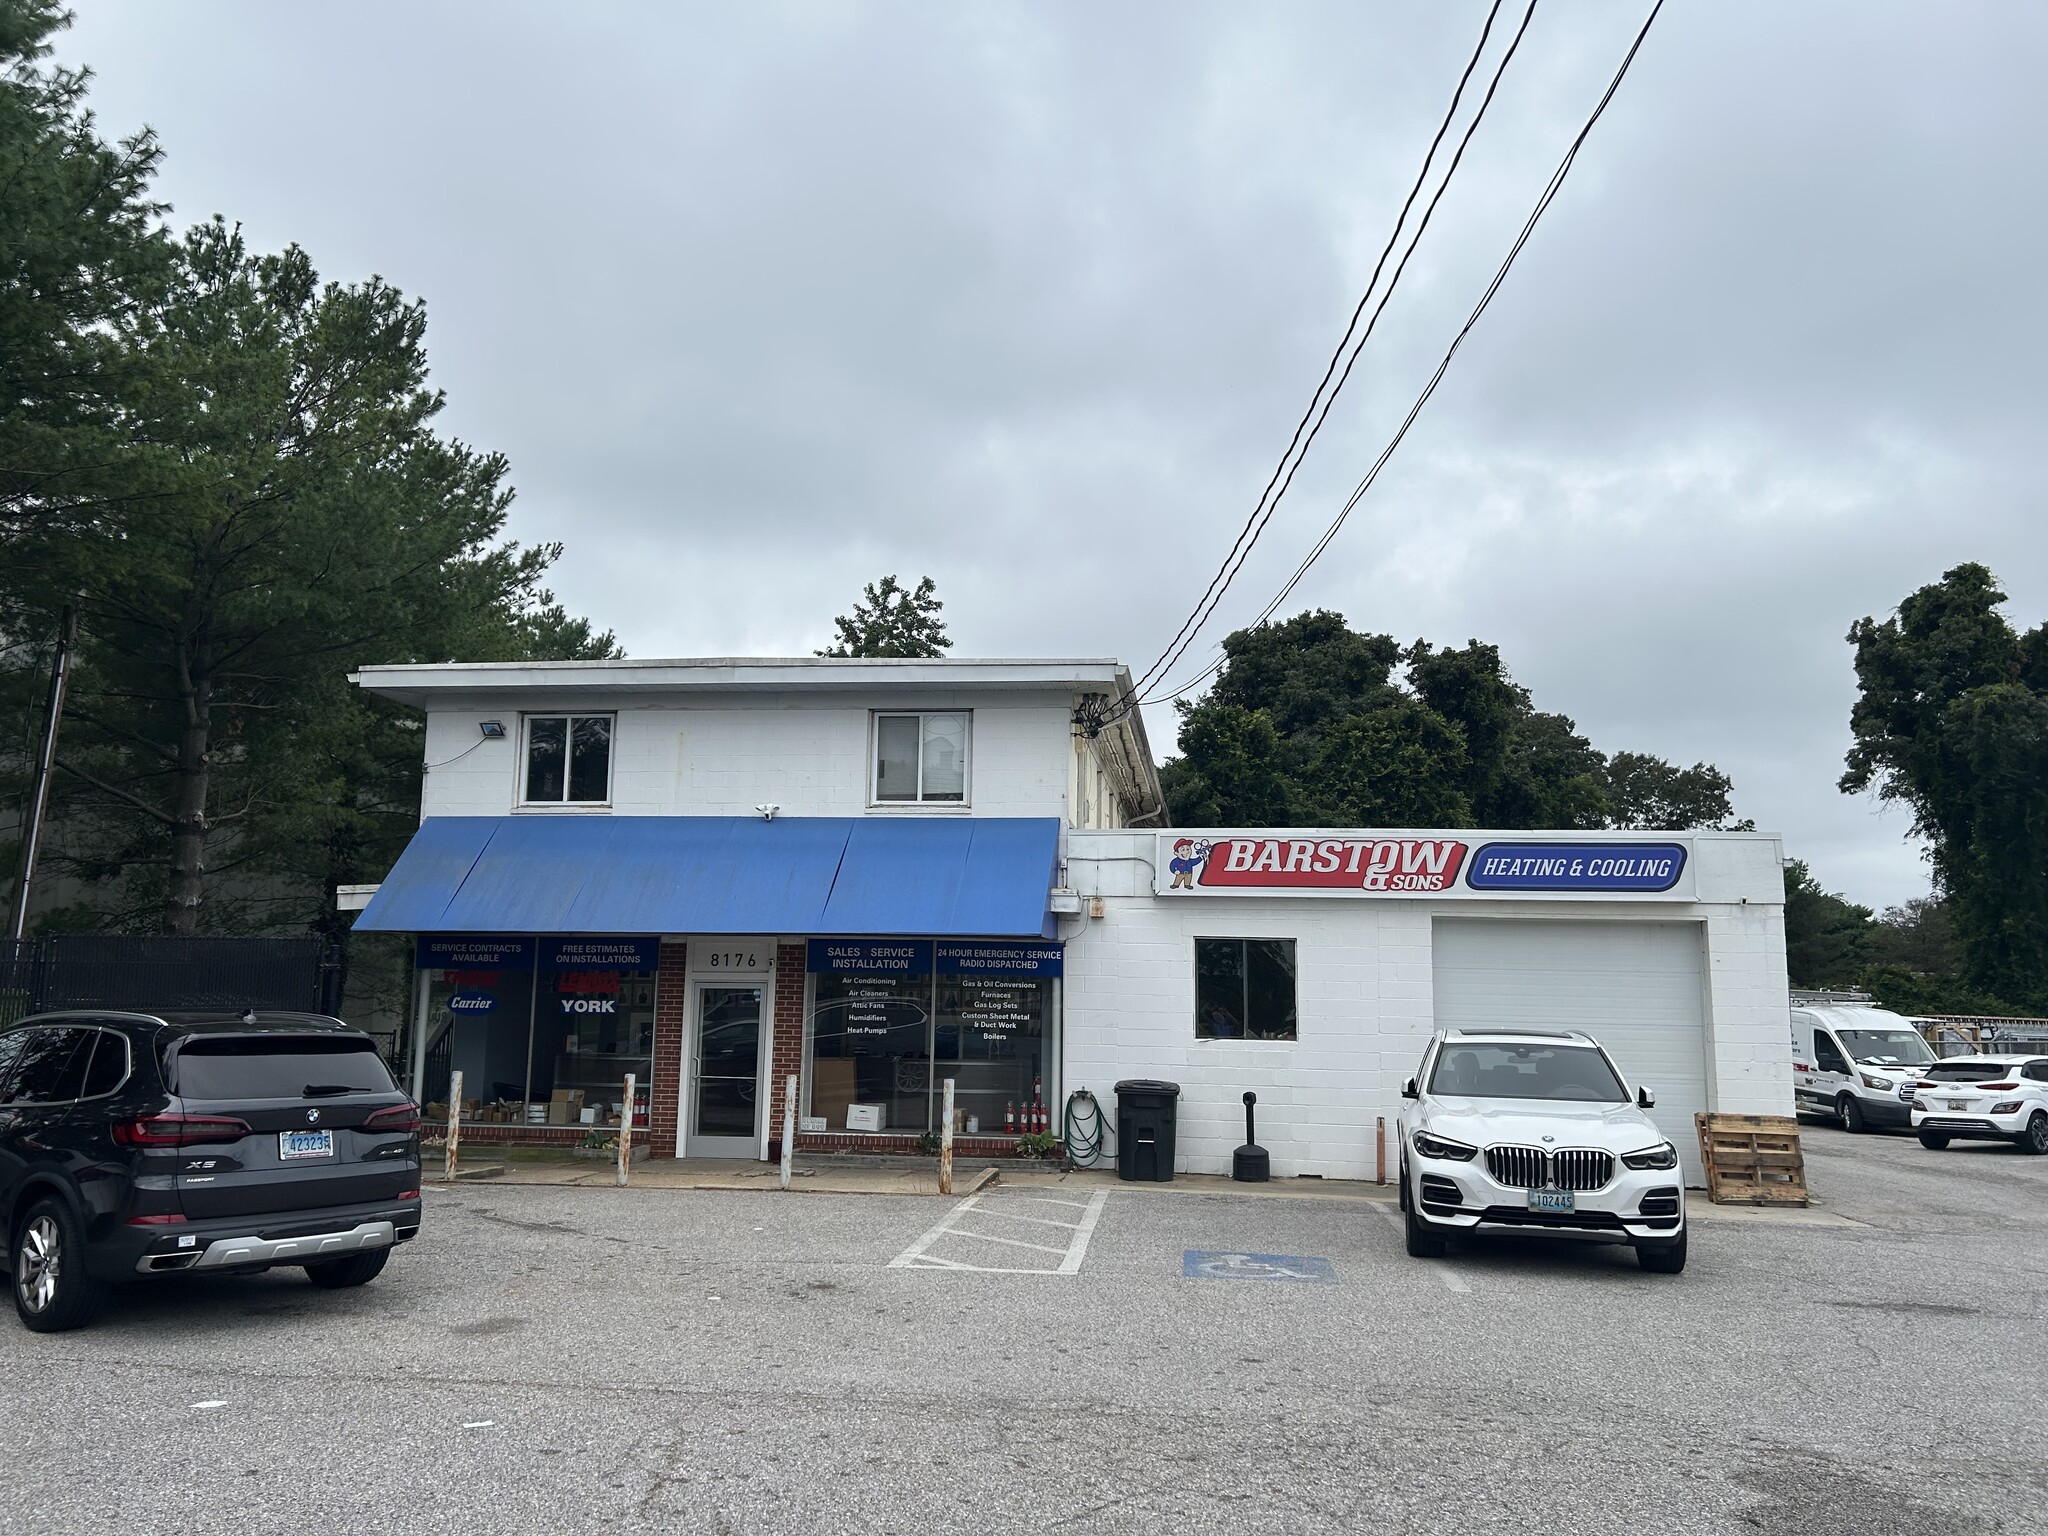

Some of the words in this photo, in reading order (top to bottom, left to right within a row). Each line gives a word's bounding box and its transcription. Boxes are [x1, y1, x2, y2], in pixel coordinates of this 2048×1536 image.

[1224, 840, 1457, 874] BARSTOW
[1483, 858, 1566, 877] HEATING
[1570, 859, 1583, 876] &
[1588, 858, 1671, 878] COOLING
[1363, 863, 1388, 892] &
[1390, 874, 1444, 891] SONS
[431, 944, 467, 952] SERVICE
[469, 944, 521, 953] CONTRACTS
[563, 945, 583, 953] FREE
[586, 945, 635, 953] ESTIMATES
[827, 947, 860, 956] SALES
[871, 948, 914, 957] SERVICE
[452, 953, 499, 962] AVAILABLE
[938, 949, 948, 957] 24
[949, 949, 972, 957] HOUR
[974, 949, 1025, 958] EMERGENCY
[1027, 951, 1061, 959] SERVICE
[556, 955, 569, 963] ON
[572, 955, 640, 963] INSTALLATIONS
[711, 953, 755, 967] 8176
[832, 959, 908, 969] INSTALLATION
[960, 960, 985, 968] RADIO
[987, 960, 1038, 969] DISPATCHED
[854, 977, 896, 986] Conditioning
[995, 981, 1036, 989] Conversions
[451, 997, 491, 1009] Carrier
[561, 1000, 615, 1013] YORK
[989, 1002, 1001, 1010] Log
[866, 1027, 887, 1035] Pumps
[185, 1161, 216, 1169] X5
